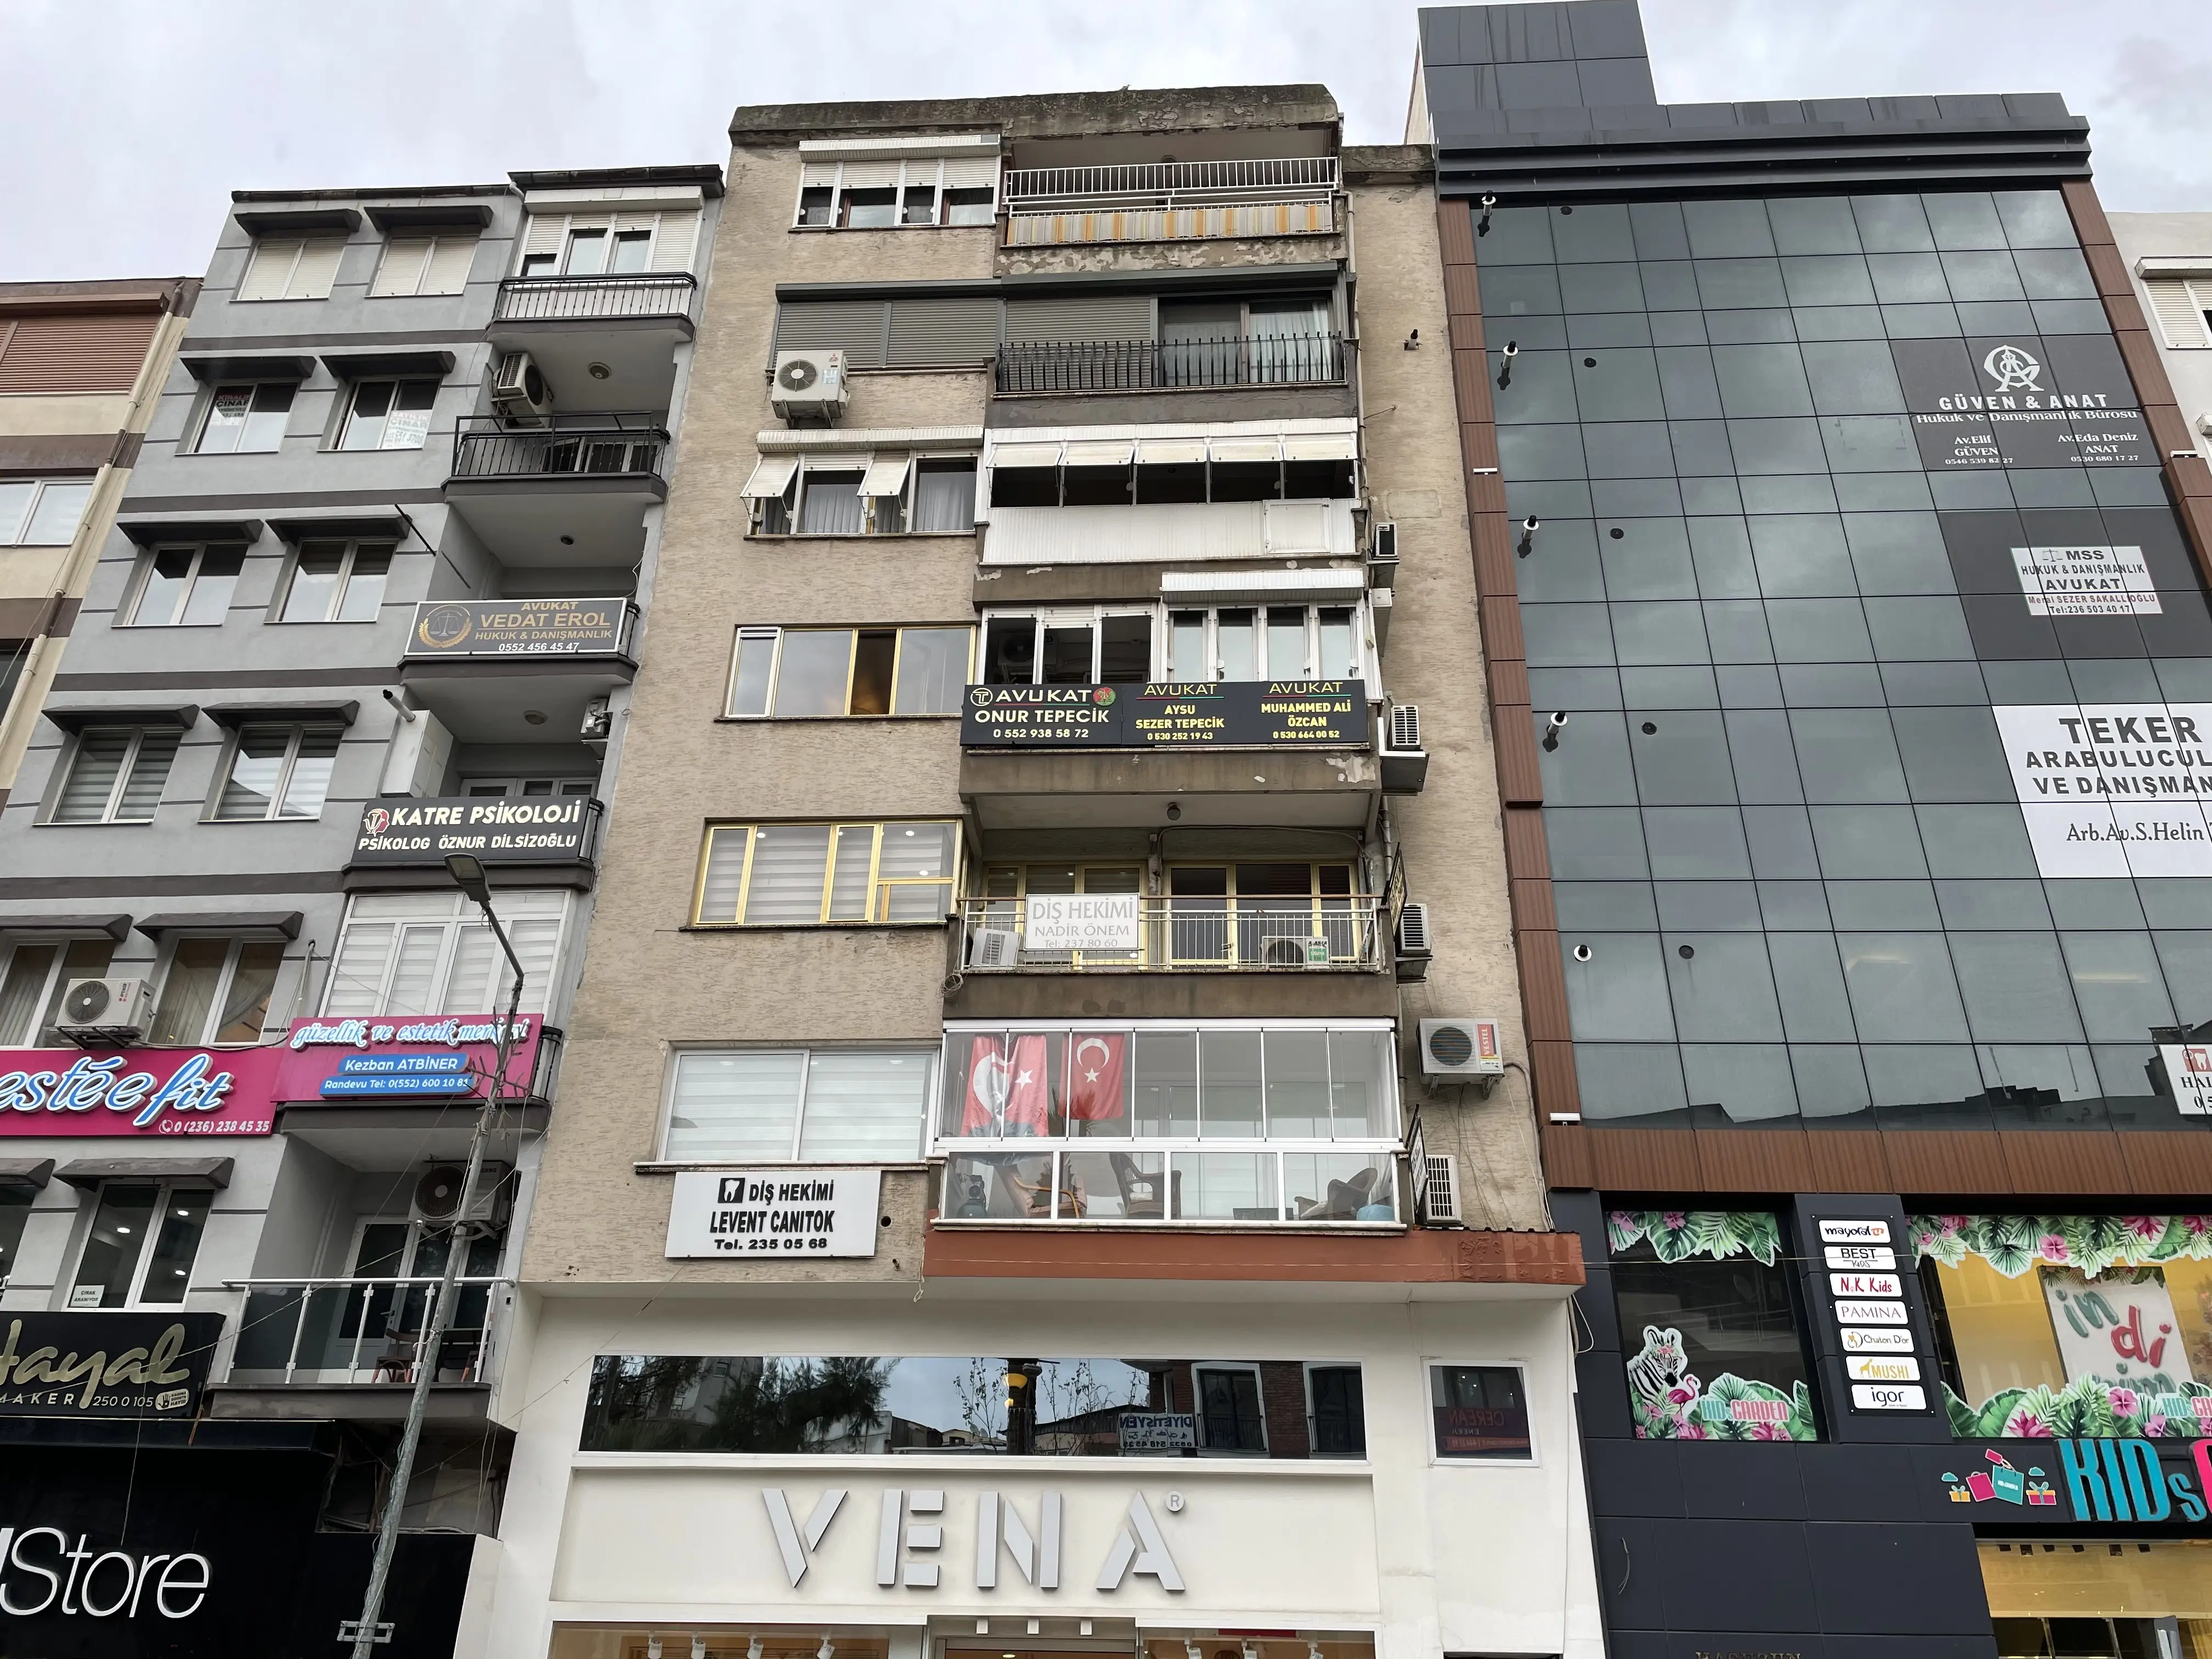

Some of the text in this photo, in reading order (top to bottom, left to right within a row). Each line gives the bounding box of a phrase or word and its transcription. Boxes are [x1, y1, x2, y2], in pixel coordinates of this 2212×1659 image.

[1939, 394, 2107, 410] GÜVEN & ANAT
[1916, 409, 2138, 424] Hukuk ve Danışmanlık Bürosu
[2102, 432, 2138, 441] Deniz
[1954, 446, 1999, 456] GÜVEN
[2085, 445, 2118, 453] ANAT
[2066, 550, 2104, 561] MSS
[2021, 564, 2145, 576] HUKUK & DANIŞMANLIK
[2046, 578, 2120, 590] AVUKAT
[521, 602, 579, 611] AVUKAT
[480, 612, 611, 628] VEDAT EROL
[475, 629, 613, 642] HUKUK & DANIŞMANLIK
[498, 643, 524, 651] 0552
[565, 642, 580, 651] 47
[1144, 684, 1217, 696] AVUKAT
[1269, 682, 1343, 693] AVUKAT
[995, 690, 1092, 702] AVUKAT
[1164, 705, 1195, 715] AYSU
[1261, 699, 1351, 713] MUHAMMED ALİ
[975, 708, 1109, 723] ONUR TEPECİK
[1288, 715, 1327, 726] ÖZCAN
[1136, 716, 1224, 729] SEZER TEPECİK
[993, 729, 1089, 738] 0 552 938 58 72
[2059, 717, 2203, 744] TEKER
[2033, 777, 2069, 794] VE
[391, 799, 581, 826] KATRE PSİKOLOJİ
[358, 833, 577, 850] PSİKOLOG ÖZNUR DİLSİZOĞLU
[1032, 897, 1133, 924] DİŞ HEKİMİ
[1035, 923, 1129, 936] NADİR ÖNEM
[290, 1017, 530, 1049] güzellik ve estetik merkzi
[1482, 1027, 1490, 1054] VESTEL
[345, 1055, 458, 1072] Kezban ATBİNER
[132, 1053, 235, 1127] fit
[325, 1080, 368, 1089] Randevu
[370, 1080, 385, 1088] Tel:
[388, 1079, 419, 1089] 0(552)
[422, 1079, 439, 1087] 600
[174, 1120, 270, 1134] 0 (236) 238 45 35
[749, 1180, 834, 1206] DİŞ HEKİMİ
[709, 1210, 834, 1233] LEVENT CANITOK
[1825, 1226, 1871, 1238] mayoral
[714, 1238, 827, 1250] Tel. 235 05 68
[1841, 1249, 1876, 1259] BEST
[1870, 1277, 1892, 1293] Kids
[1841, 1306, 1901, 1318] PAMINA
[2056, 1289, 2120, 1338] in
[1864, 1335, 1892, 1344] Chaton
[2111, 1304, 2171, 1368] di
[1871, 1365, 1909, 1379] MUSHI
[93, 1396, 118, 1406] 250
[133, 1396, 154, 1408] 105
[1871, 1387, 1904, 1407] igor
[761, 1488, 1186, 1592] VENA
